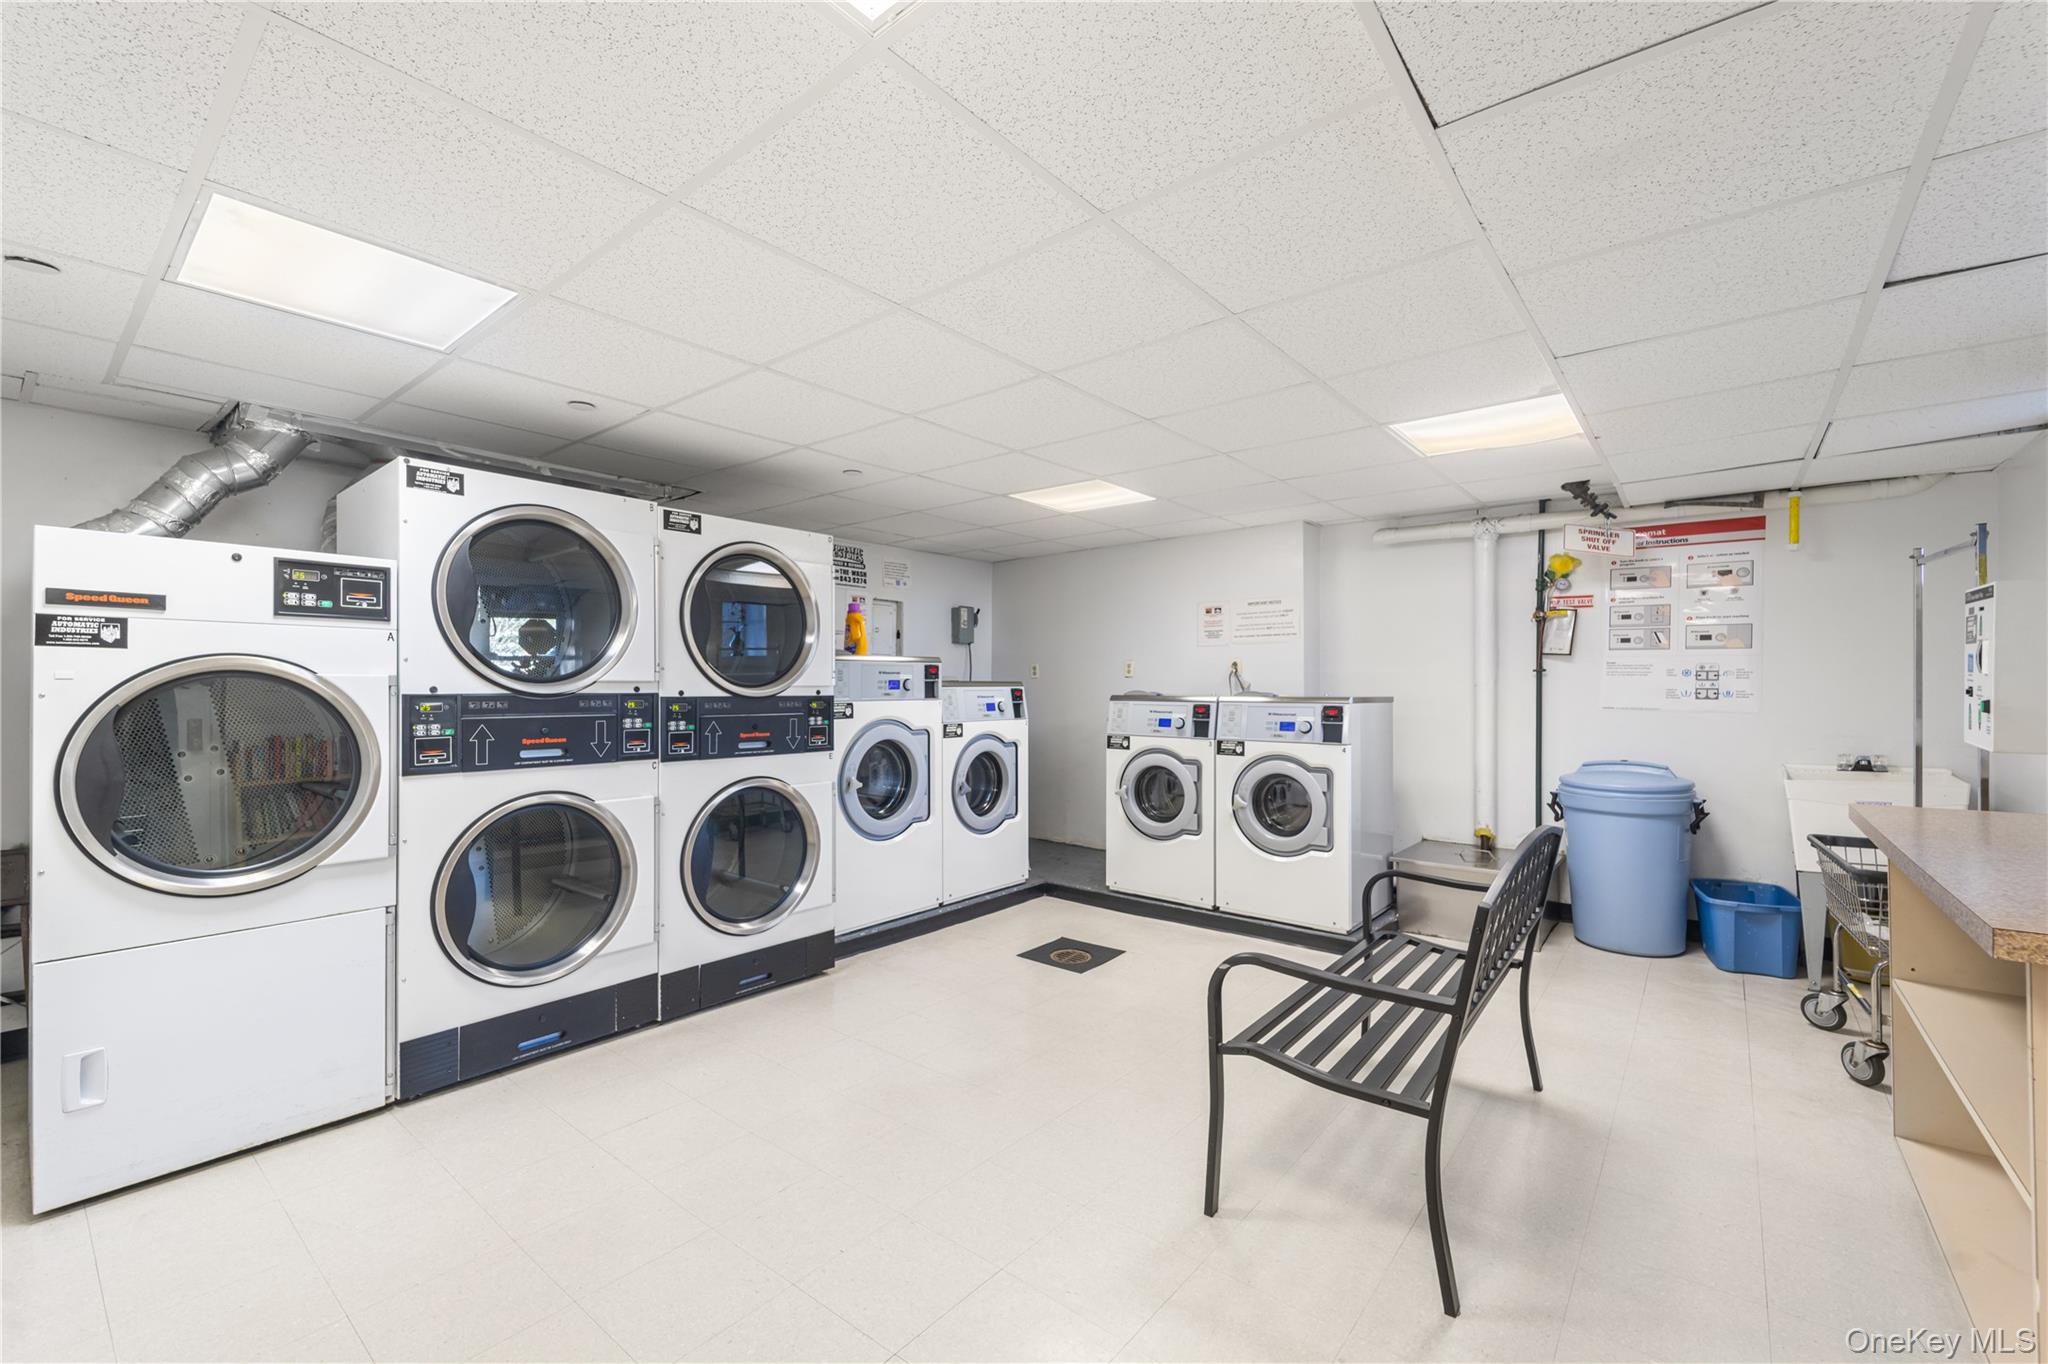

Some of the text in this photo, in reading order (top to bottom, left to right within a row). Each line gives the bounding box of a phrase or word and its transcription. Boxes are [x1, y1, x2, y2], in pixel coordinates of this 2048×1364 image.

[1581, 535, 1601, 544] SHUT
[1645, 537, 1689, 546] Instructions
[1587, 543, 1611, 552] VALVE
[65, 591, 151, 605] Speed Queen
[51, 620, 99, 629] AUTOMATIC
[50, 626, 99, 635] INDUSTRIES
[387, 632, 395, 642] A
[521, 736, 568, 746] Speed Queen
